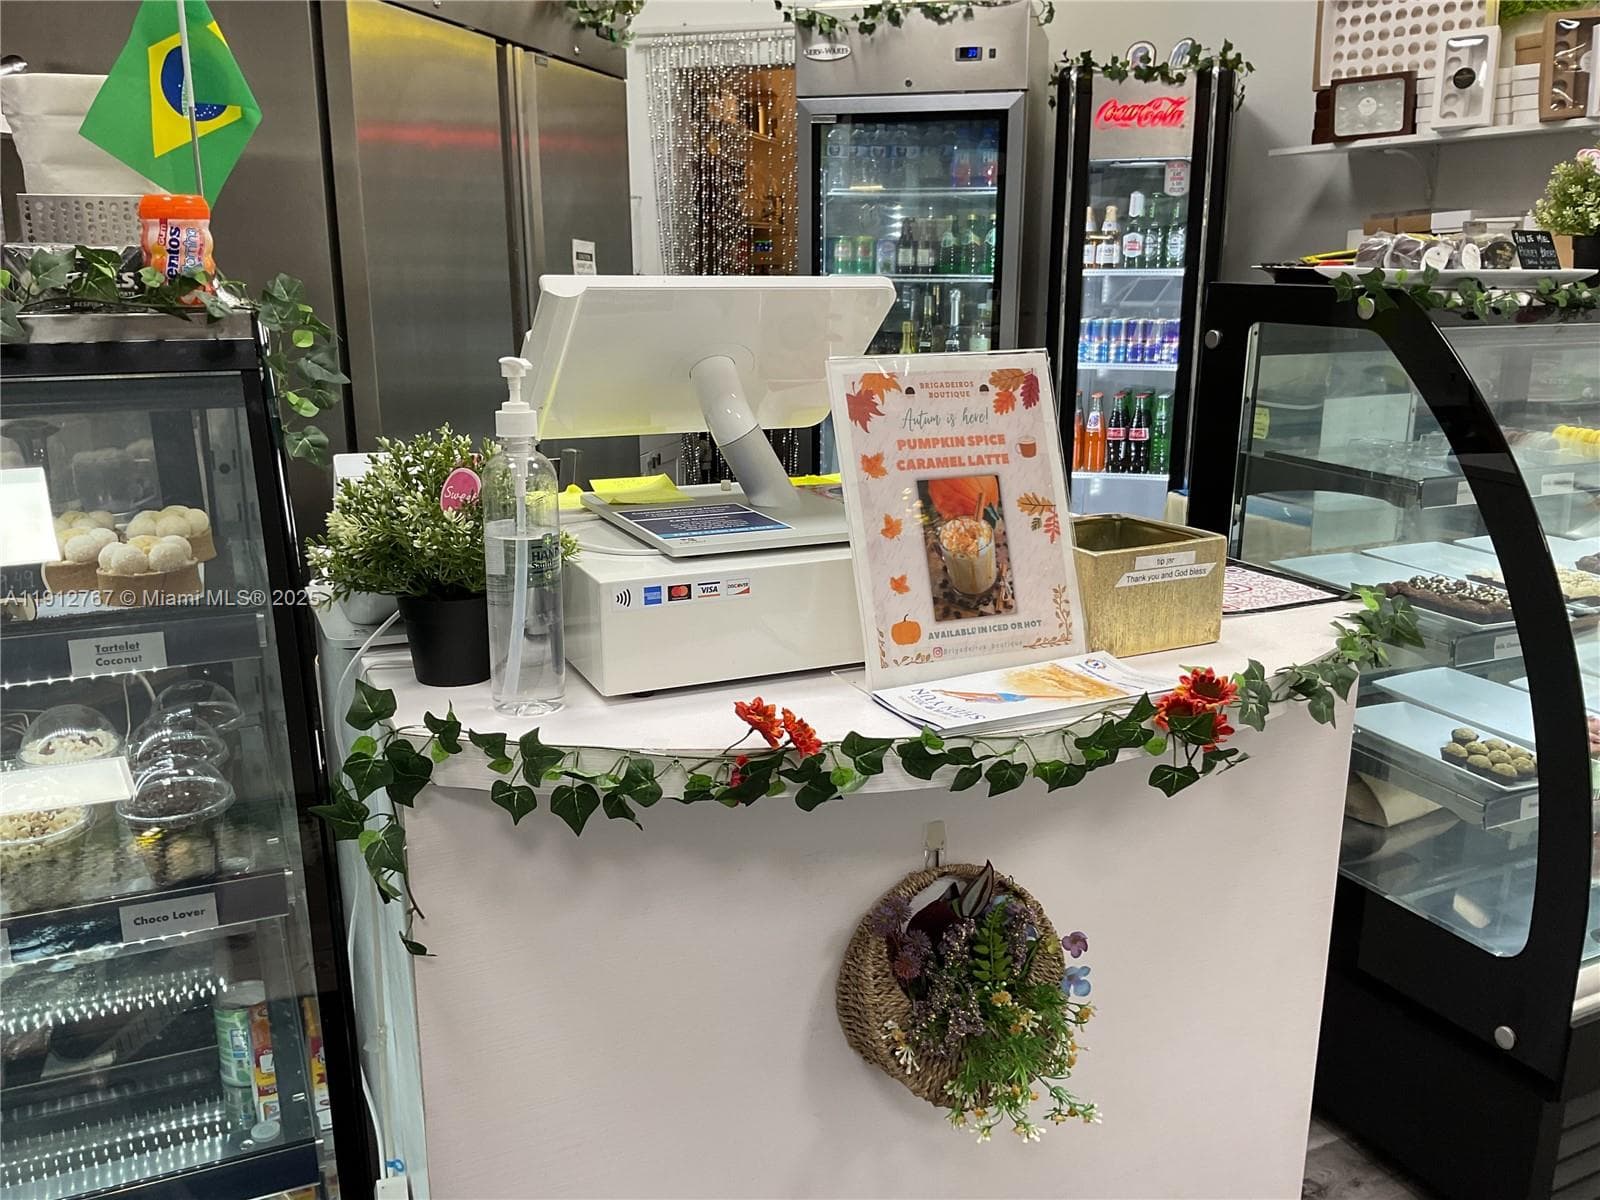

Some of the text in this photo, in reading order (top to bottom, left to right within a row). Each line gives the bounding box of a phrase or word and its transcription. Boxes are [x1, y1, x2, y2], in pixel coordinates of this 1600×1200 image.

[167, 226, 180, 279] entos
[919, 381, 974, 389] BRIGADEIROS
[928, 390, 971, 398] BOUTIQUE
[962, 407, 989, 425] here!
[896, 434, 1006, 451] PUMPKIN SPICE
[896, 453, 1009, 471] CARAMEL LATTE
[1127, 575, 1146, 584] Thank
[1148, 574, 1160, 582] you
[1174, 569, 1188, 578] God
[1189, 568, 1207, 576] bless
[701, 586, 719, 594] VISA
[928, 620, 1042, 640] AVAILABLE IN ICED OR HOT
[95, 641, 140, 653] Tartelet
[96, 655, 142, 667] Coconut
[133, 909, 206, 925] Choco Lover
